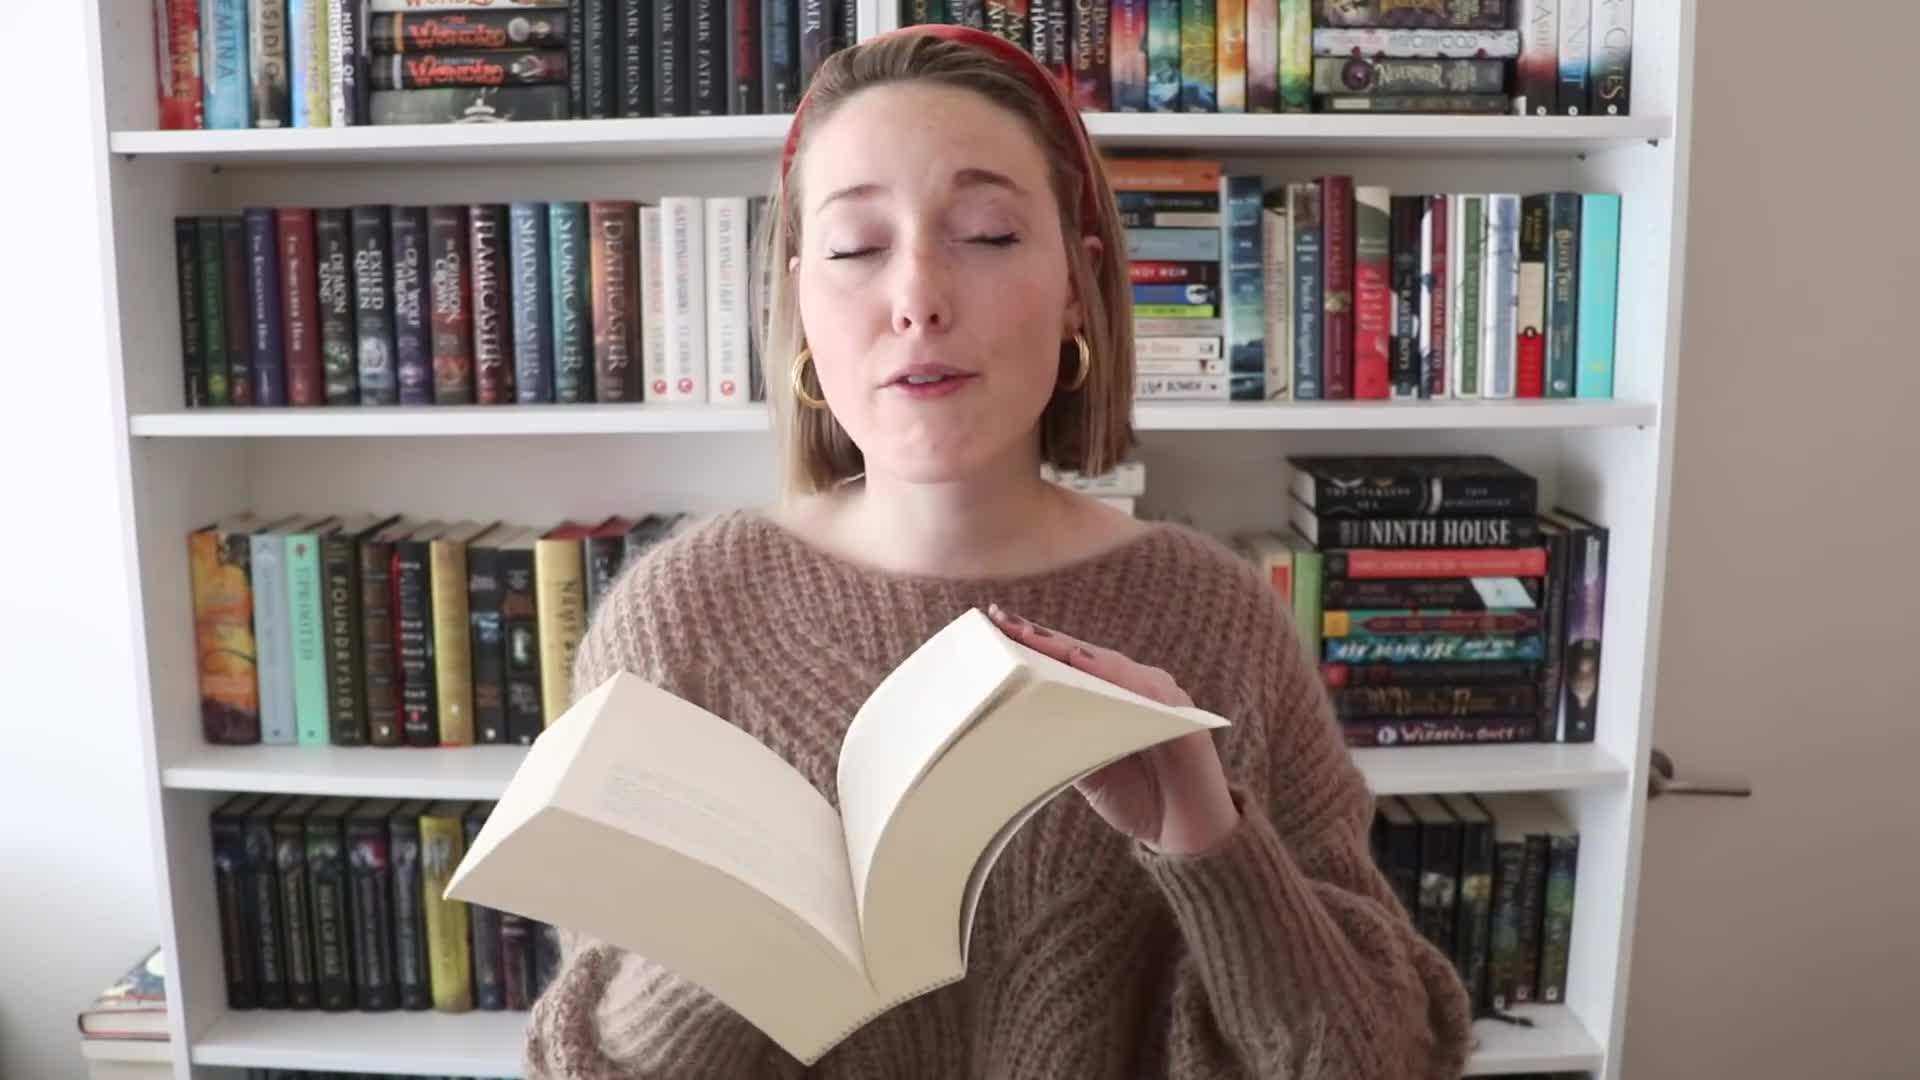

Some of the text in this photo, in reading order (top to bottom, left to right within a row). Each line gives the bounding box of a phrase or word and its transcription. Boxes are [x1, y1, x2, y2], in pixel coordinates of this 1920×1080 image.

[329, 252, 347, 314] DEMON
[354, 249, 370, 310] QUEEN
[369, 249, 384, 311] EXILED
[558, 219, 584, 374] STORMCASTER
[603, 220, 629, 372] DEATHCASTER
[1368, 519, 1436, 545] NINTH
[1443, 519, 1512, 545] HOUSE
[331, 576, 354, 721] FOUNDRYSIDE
